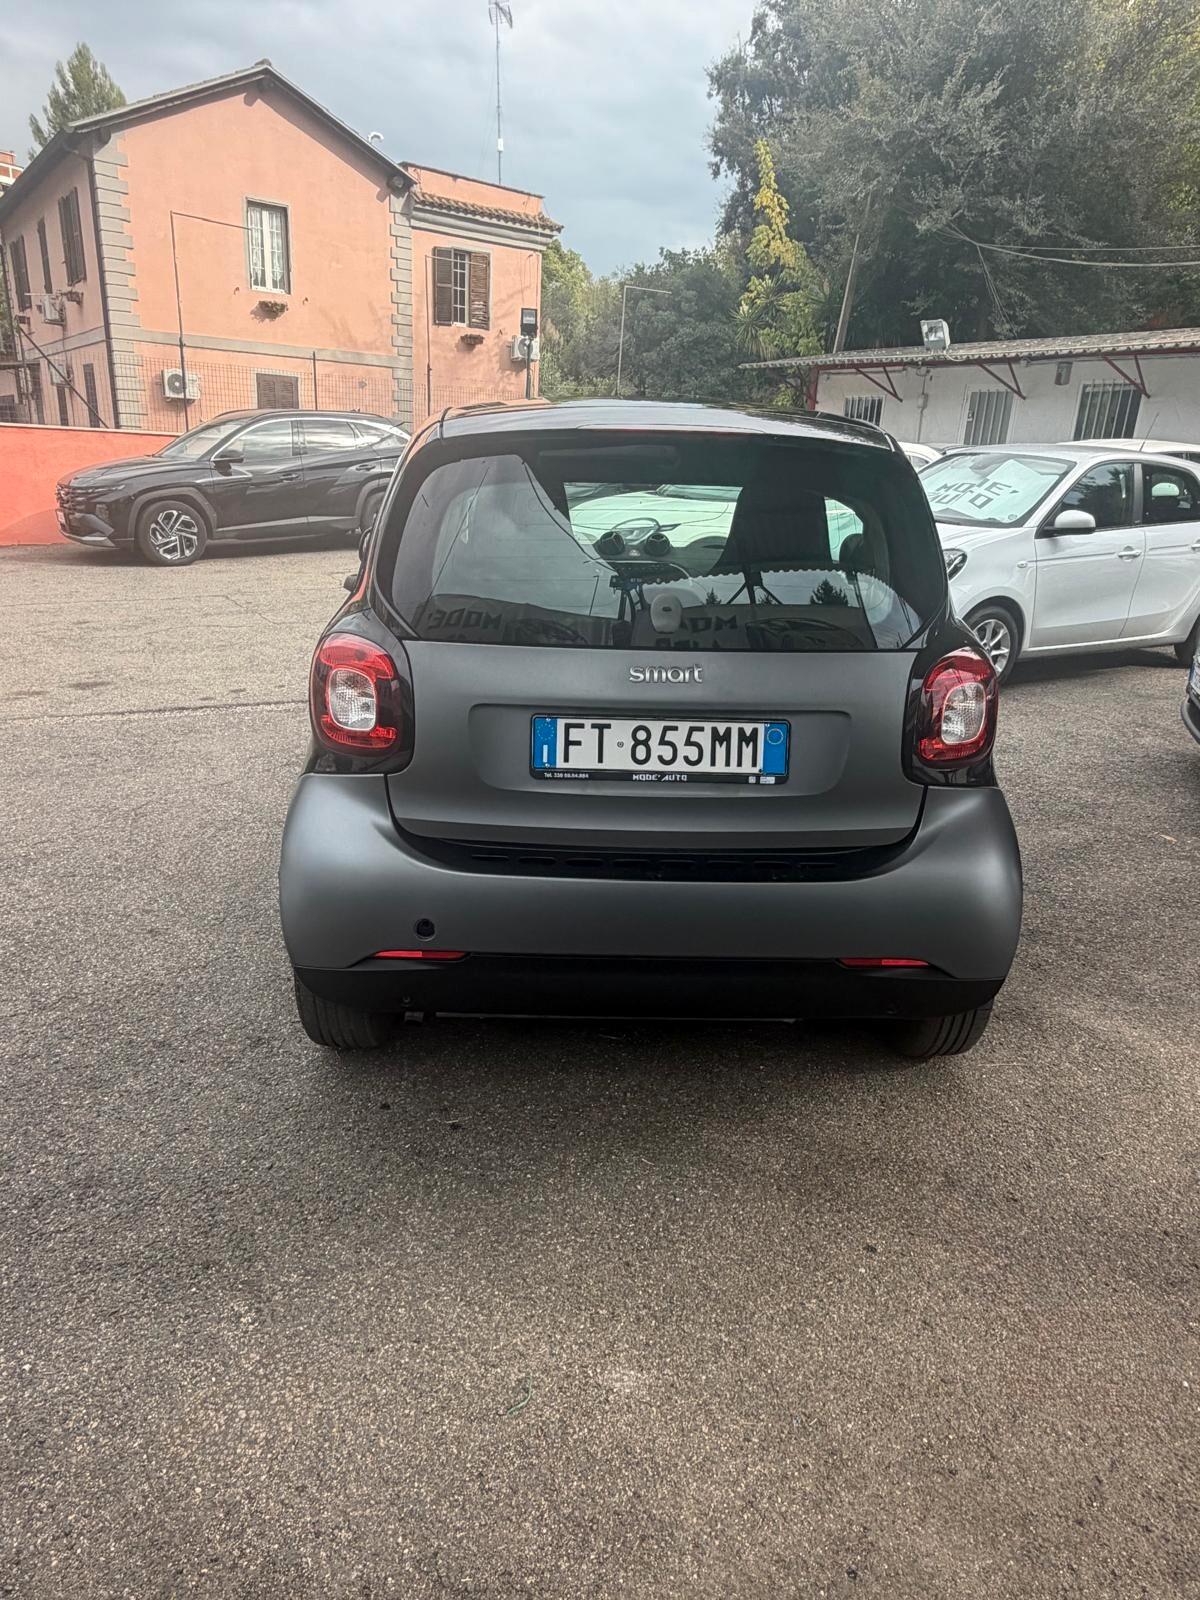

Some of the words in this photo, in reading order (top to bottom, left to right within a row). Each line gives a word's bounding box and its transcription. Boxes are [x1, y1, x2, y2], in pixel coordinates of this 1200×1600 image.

[629, 664, 703, 683] smart
[563, 723, 611, 763] FT
[630, 725, 759, 767] 855MM
[661, 774, 688, 782] AUTO
